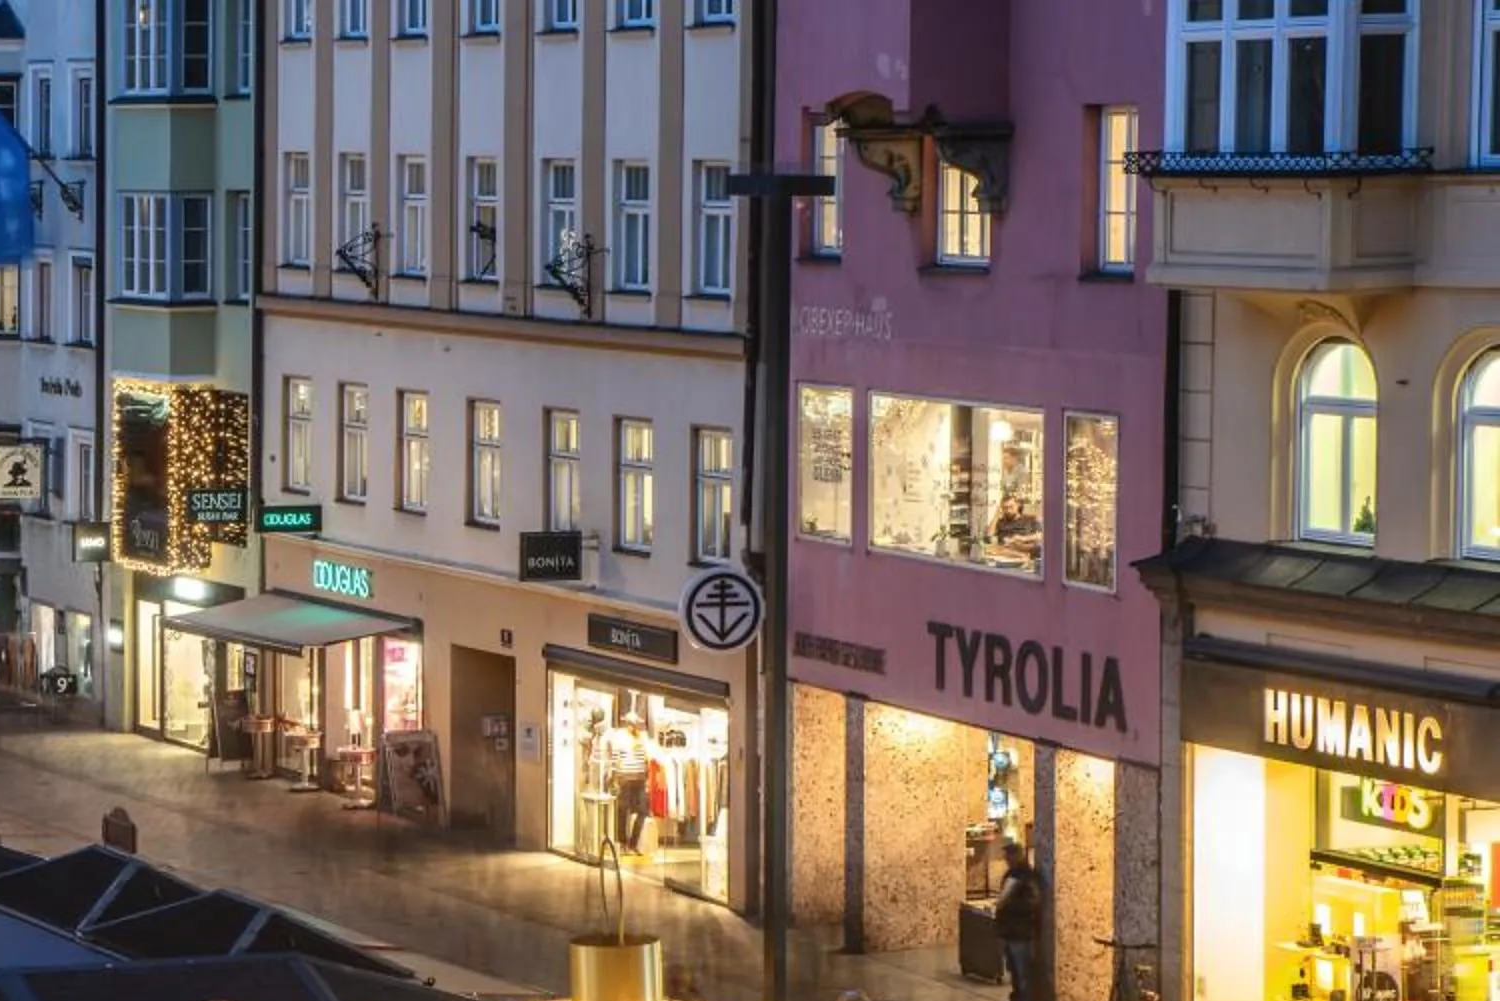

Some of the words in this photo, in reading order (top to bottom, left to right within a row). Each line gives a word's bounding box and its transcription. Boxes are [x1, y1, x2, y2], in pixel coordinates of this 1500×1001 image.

[192, 492, 242, 510] SENSEI
[263, 513, 312, 526] DOUGLAS
[528, 553, 575, 572] BONITA
[313, 560, 369, 598] DOUGLAS
[611, 629, 641, 650] BONITA
[927, 622, 1128, 733] TYROLIA
[1264, 689, 1443, 774] HUMANIC
[1360, 777, 1431, 830] KIDS
